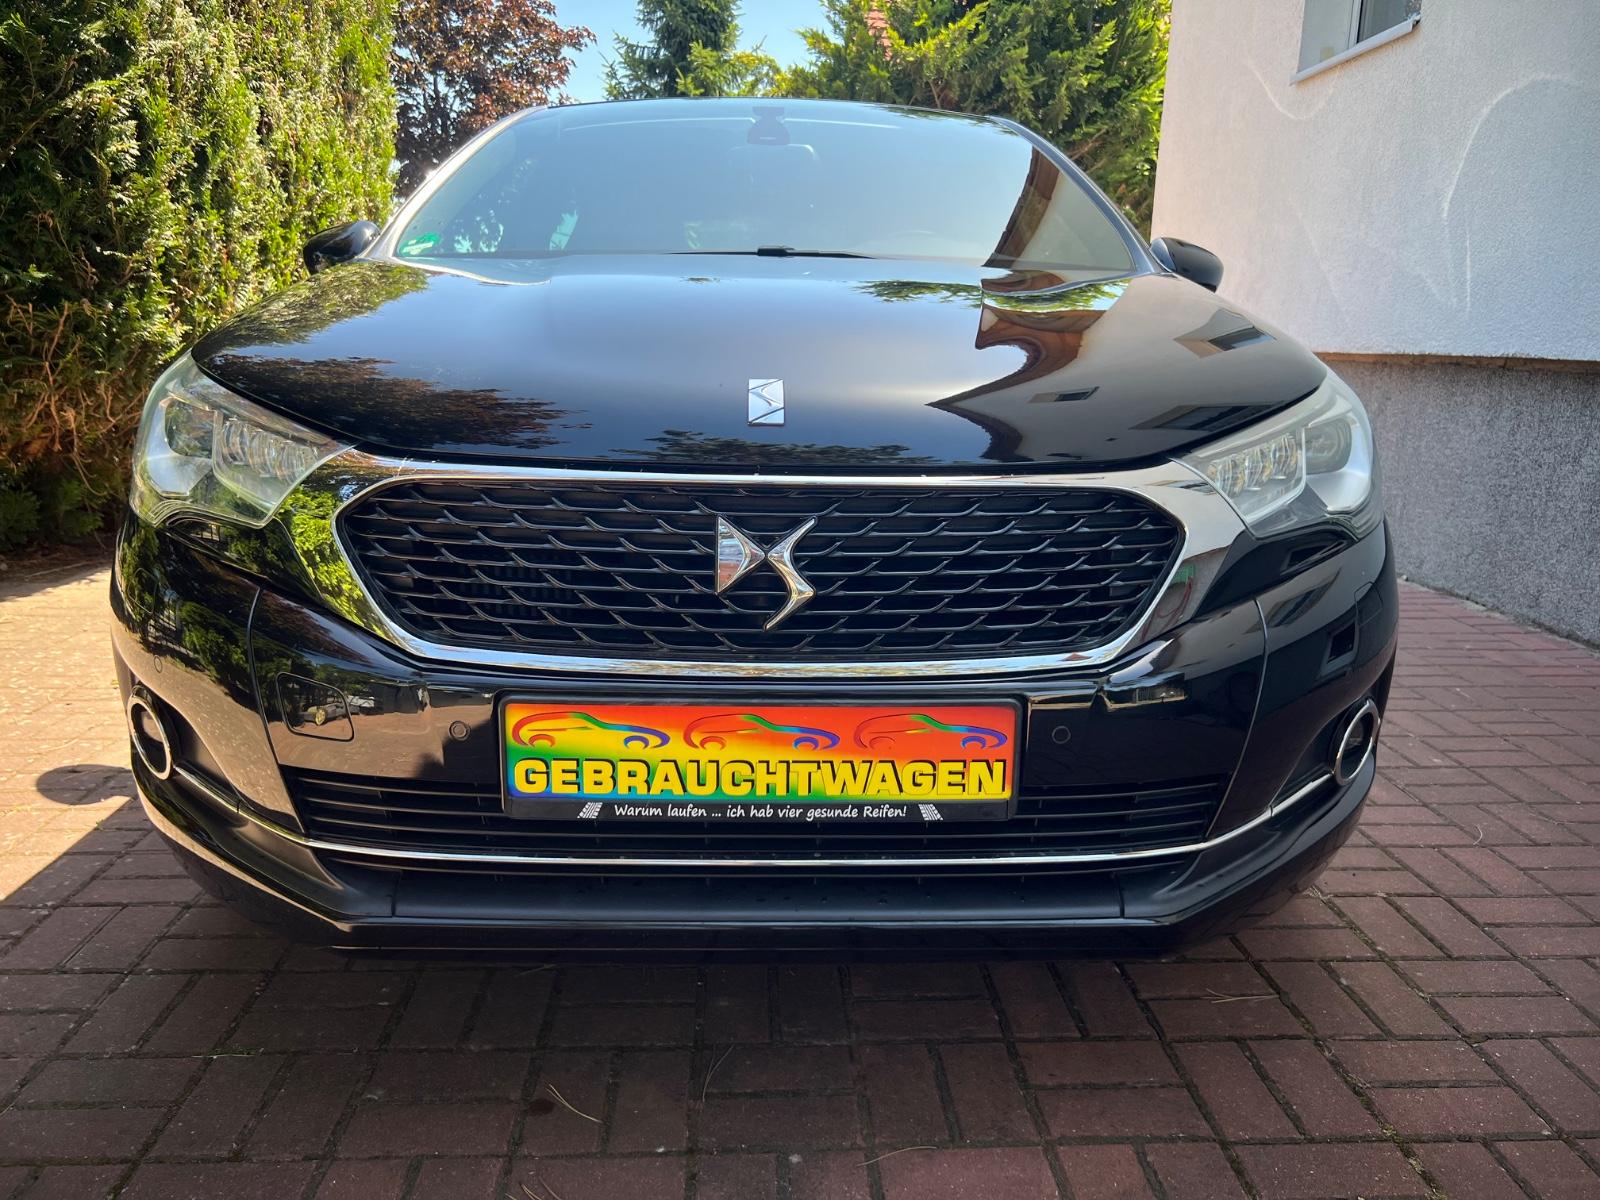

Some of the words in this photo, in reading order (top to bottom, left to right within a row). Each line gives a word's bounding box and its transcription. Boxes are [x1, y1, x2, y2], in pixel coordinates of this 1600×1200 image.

[513, 757, 1007, 796] GEBRAUCHTWAGEN
[614, 804, 663, 817] Warum
[667, 803, 707, 818] laufen
[726, 804, 746, 818] ich
[749, 804, 774, 818] hab
[778, 804, 804, 818] vier
[805, 804, 859, 822] gesunde
[862, 804, 907, 818] Reifen!
